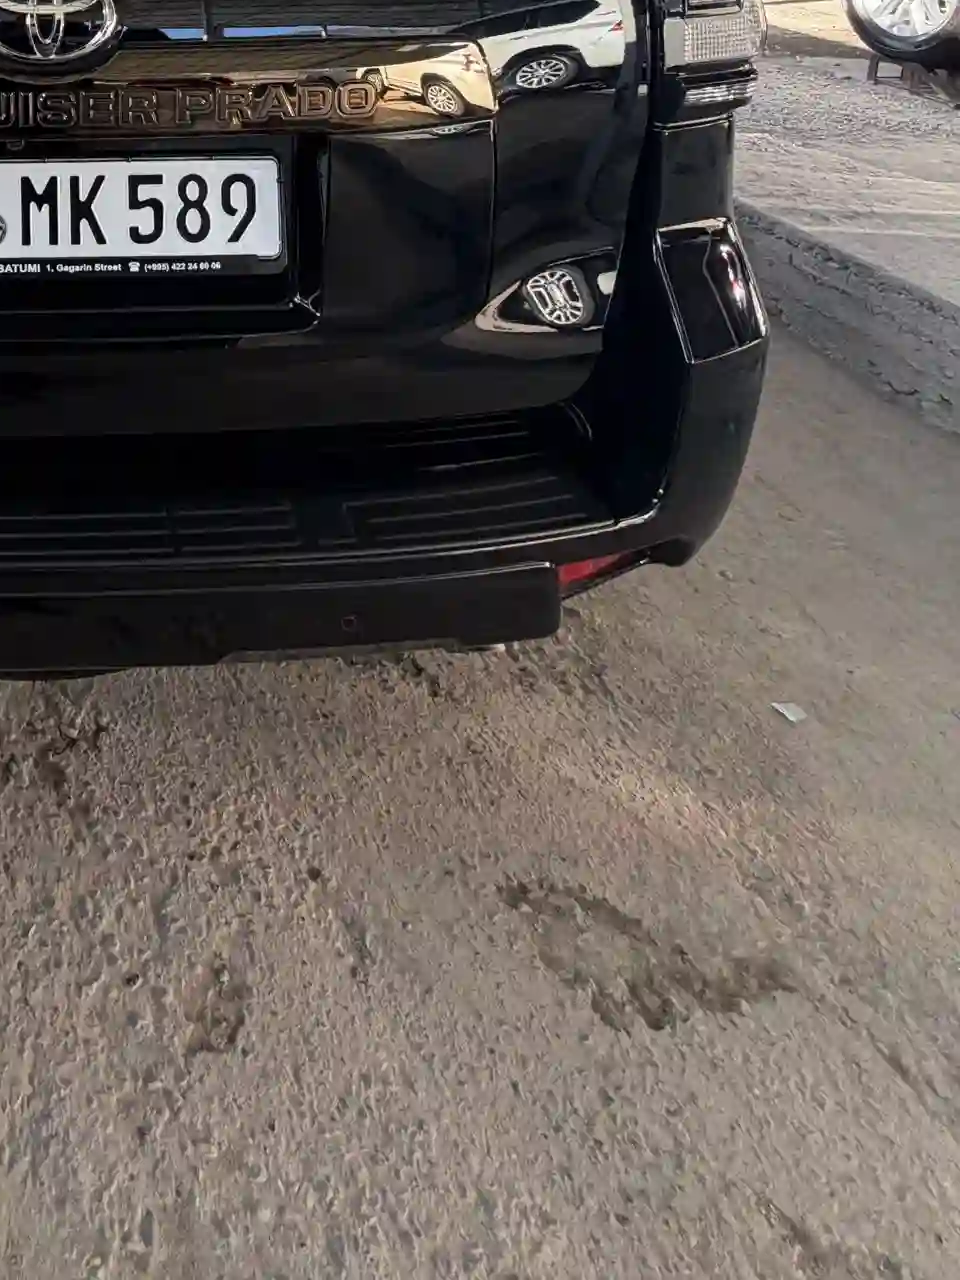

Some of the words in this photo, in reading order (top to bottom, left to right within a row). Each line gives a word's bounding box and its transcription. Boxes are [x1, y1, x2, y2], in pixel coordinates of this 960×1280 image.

[175, 80, 378, 124] PRADO
[20, 174, 107, 246] MK
[127, 172, 257, 245] 589
[56, 263, 93, 274] Gagarin
[94, 262, 122, 272] Street
